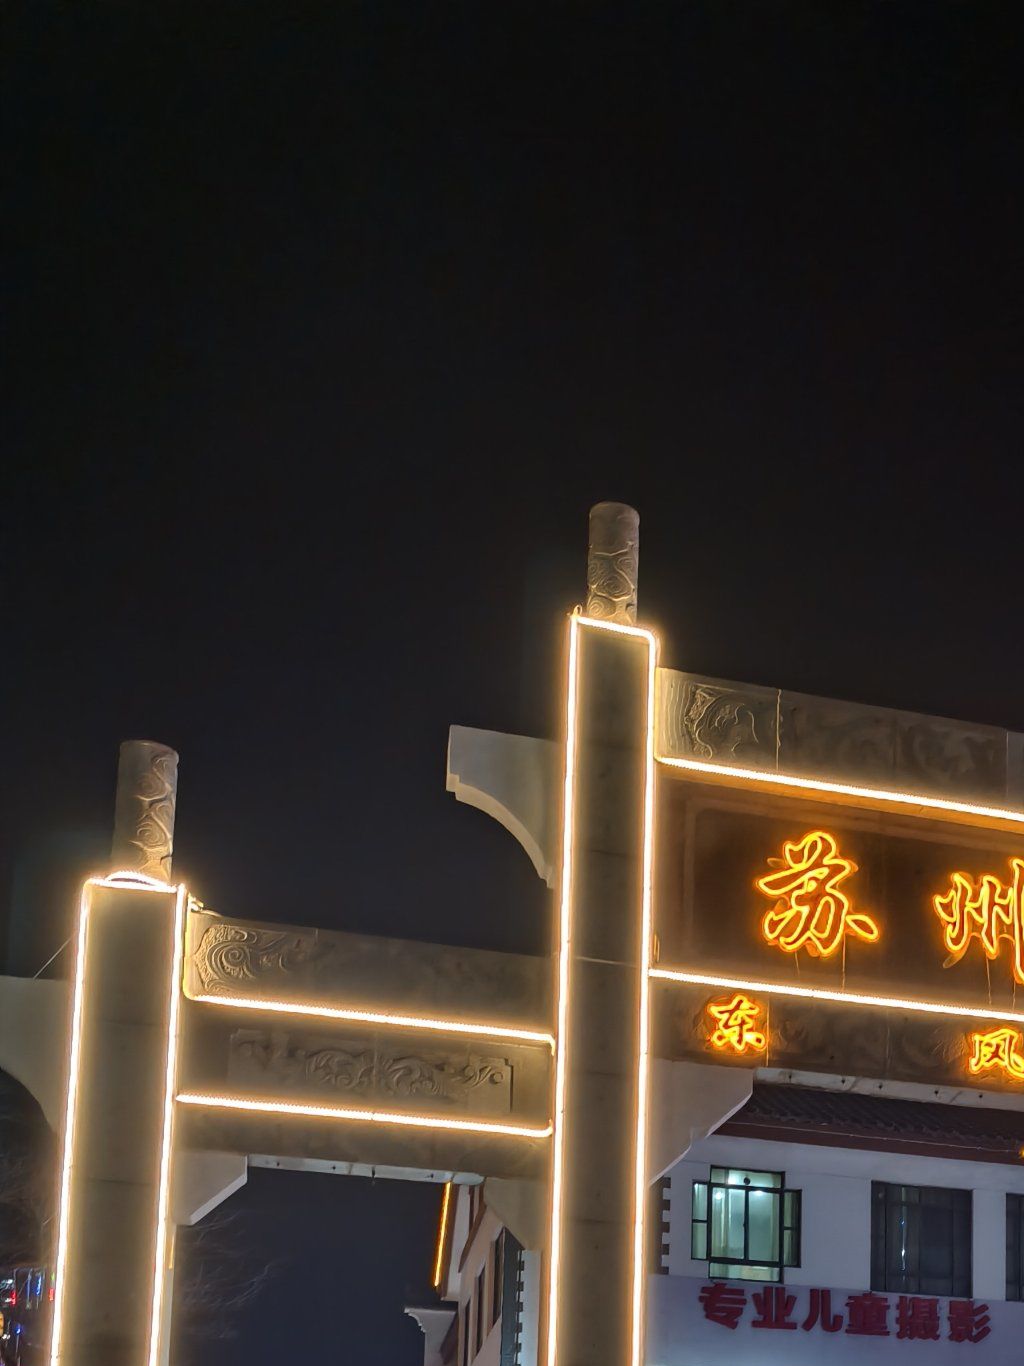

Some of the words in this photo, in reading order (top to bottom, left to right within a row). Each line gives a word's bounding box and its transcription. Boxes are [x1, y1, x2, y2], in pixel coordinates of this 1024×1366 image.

[698, 1283, 991, 1345] 专业儿童摄影
